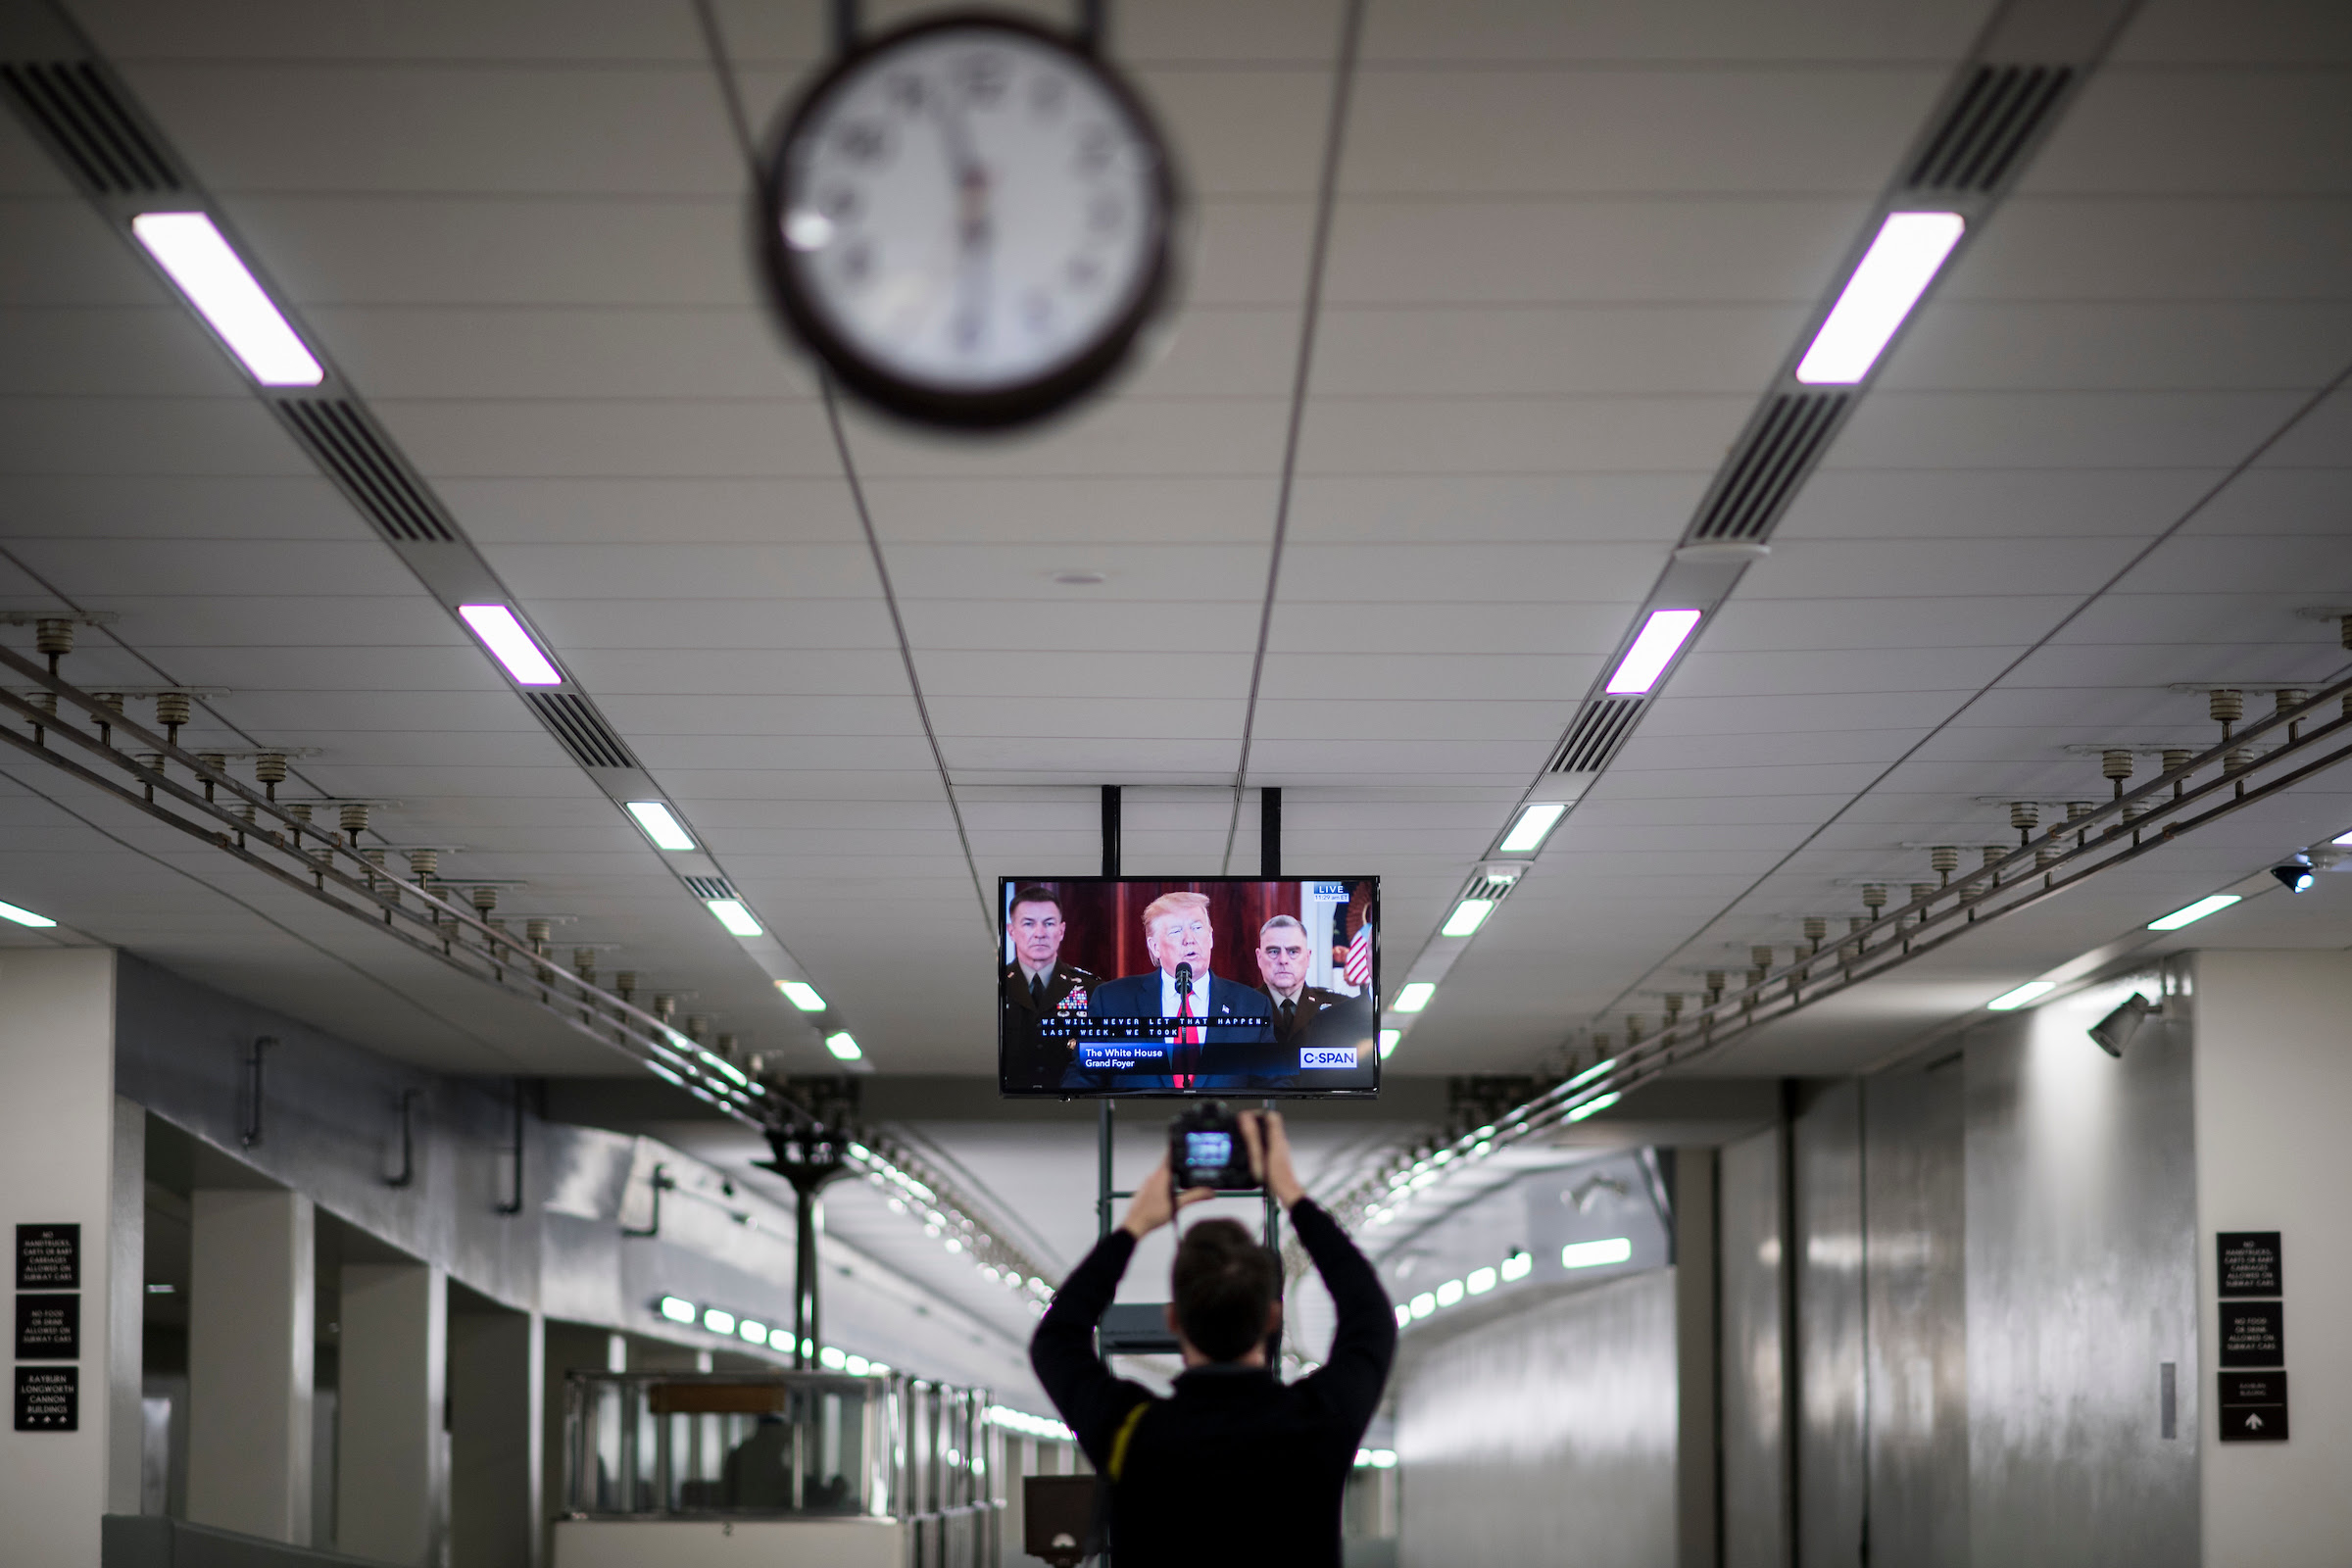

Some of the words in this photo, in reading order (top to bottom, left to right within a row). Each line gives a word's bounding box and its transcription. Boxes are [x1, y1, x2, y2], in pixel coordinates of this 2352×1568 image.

[1085, 1049, 1104, 1057] The
[1104, 1049, 1133, 1057] White
[1134, 1049, 1163, 1057] House
[1111, 1059, 1135, 1069] Foyer
[21, 1385, 74, 1394] LONGWORTH
